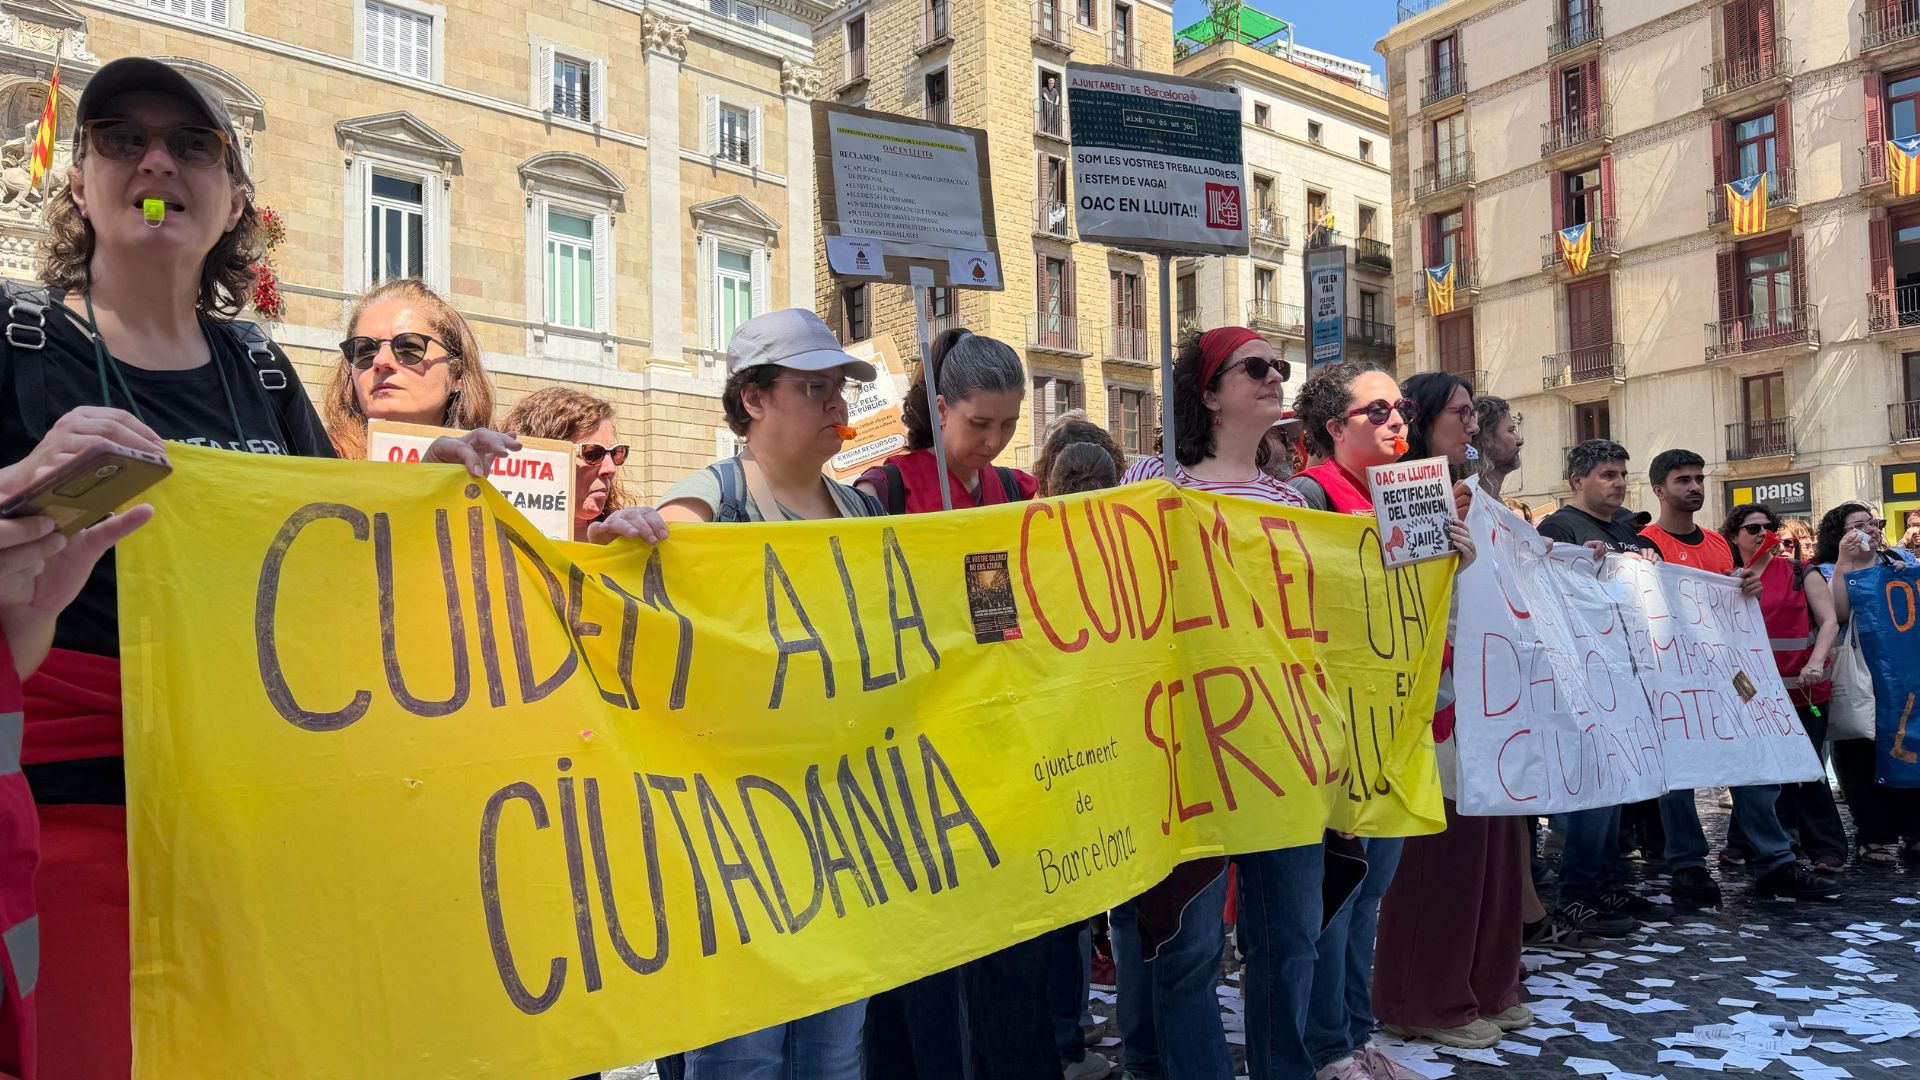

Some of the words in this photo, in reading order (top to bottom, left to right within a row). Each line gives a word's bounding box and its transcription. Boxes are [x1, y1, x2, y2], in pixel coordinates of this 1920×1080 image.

[1072, 78, 1126, 92] AJUNTAMENT
[1130, 85, 1142, 94] DE
[1144, 86, 1190, 102] Barcelona
[1146, 117, 1156, 125] no
[1183, 122, 1194, 131] joc
[839, 150, 883, 163] RECLAMEM:
[1078, 154, 1101, 164] SOM
[1104, 156, 1121, 166] LES
[1122, 157, 1165, 170] VOSTRES
[1167, 162, 1240, 181] TREBALLADORES,
[1085, 174, 1120, 185] ESTEM
[1122, 176, 1136, 186] DE
[1138, 178, 1167, 189] VAGA!
[1080, 196, 1115, 212] OAC
[1119, 198, 1140, 213] EN
[1144, 200, 1198, 218] LLUITA!!
[388, 446, 420, 464] OA
[489, 456, 554, 481] LUITA
[1375, 468, 1395, 486] OAC
[1397, 472, 1407, 483] EN
[1383, 479, 1444, 505] RECTIFICACIÓ
[1756, 481, 1804, 504] pans
[1388, 506, 1407, 522] DEL
[1259, 516, 1328, 644] EL
[1358, 526, 1431, 662] OA
[765, 542, 836, 711] A
[829, 526, 941, 692] LA
[1034, 736, 1119, 792] ajuntament
[1076, 791, 1094, 815] de
[1037, 825, 1137, 896] Barcelona
